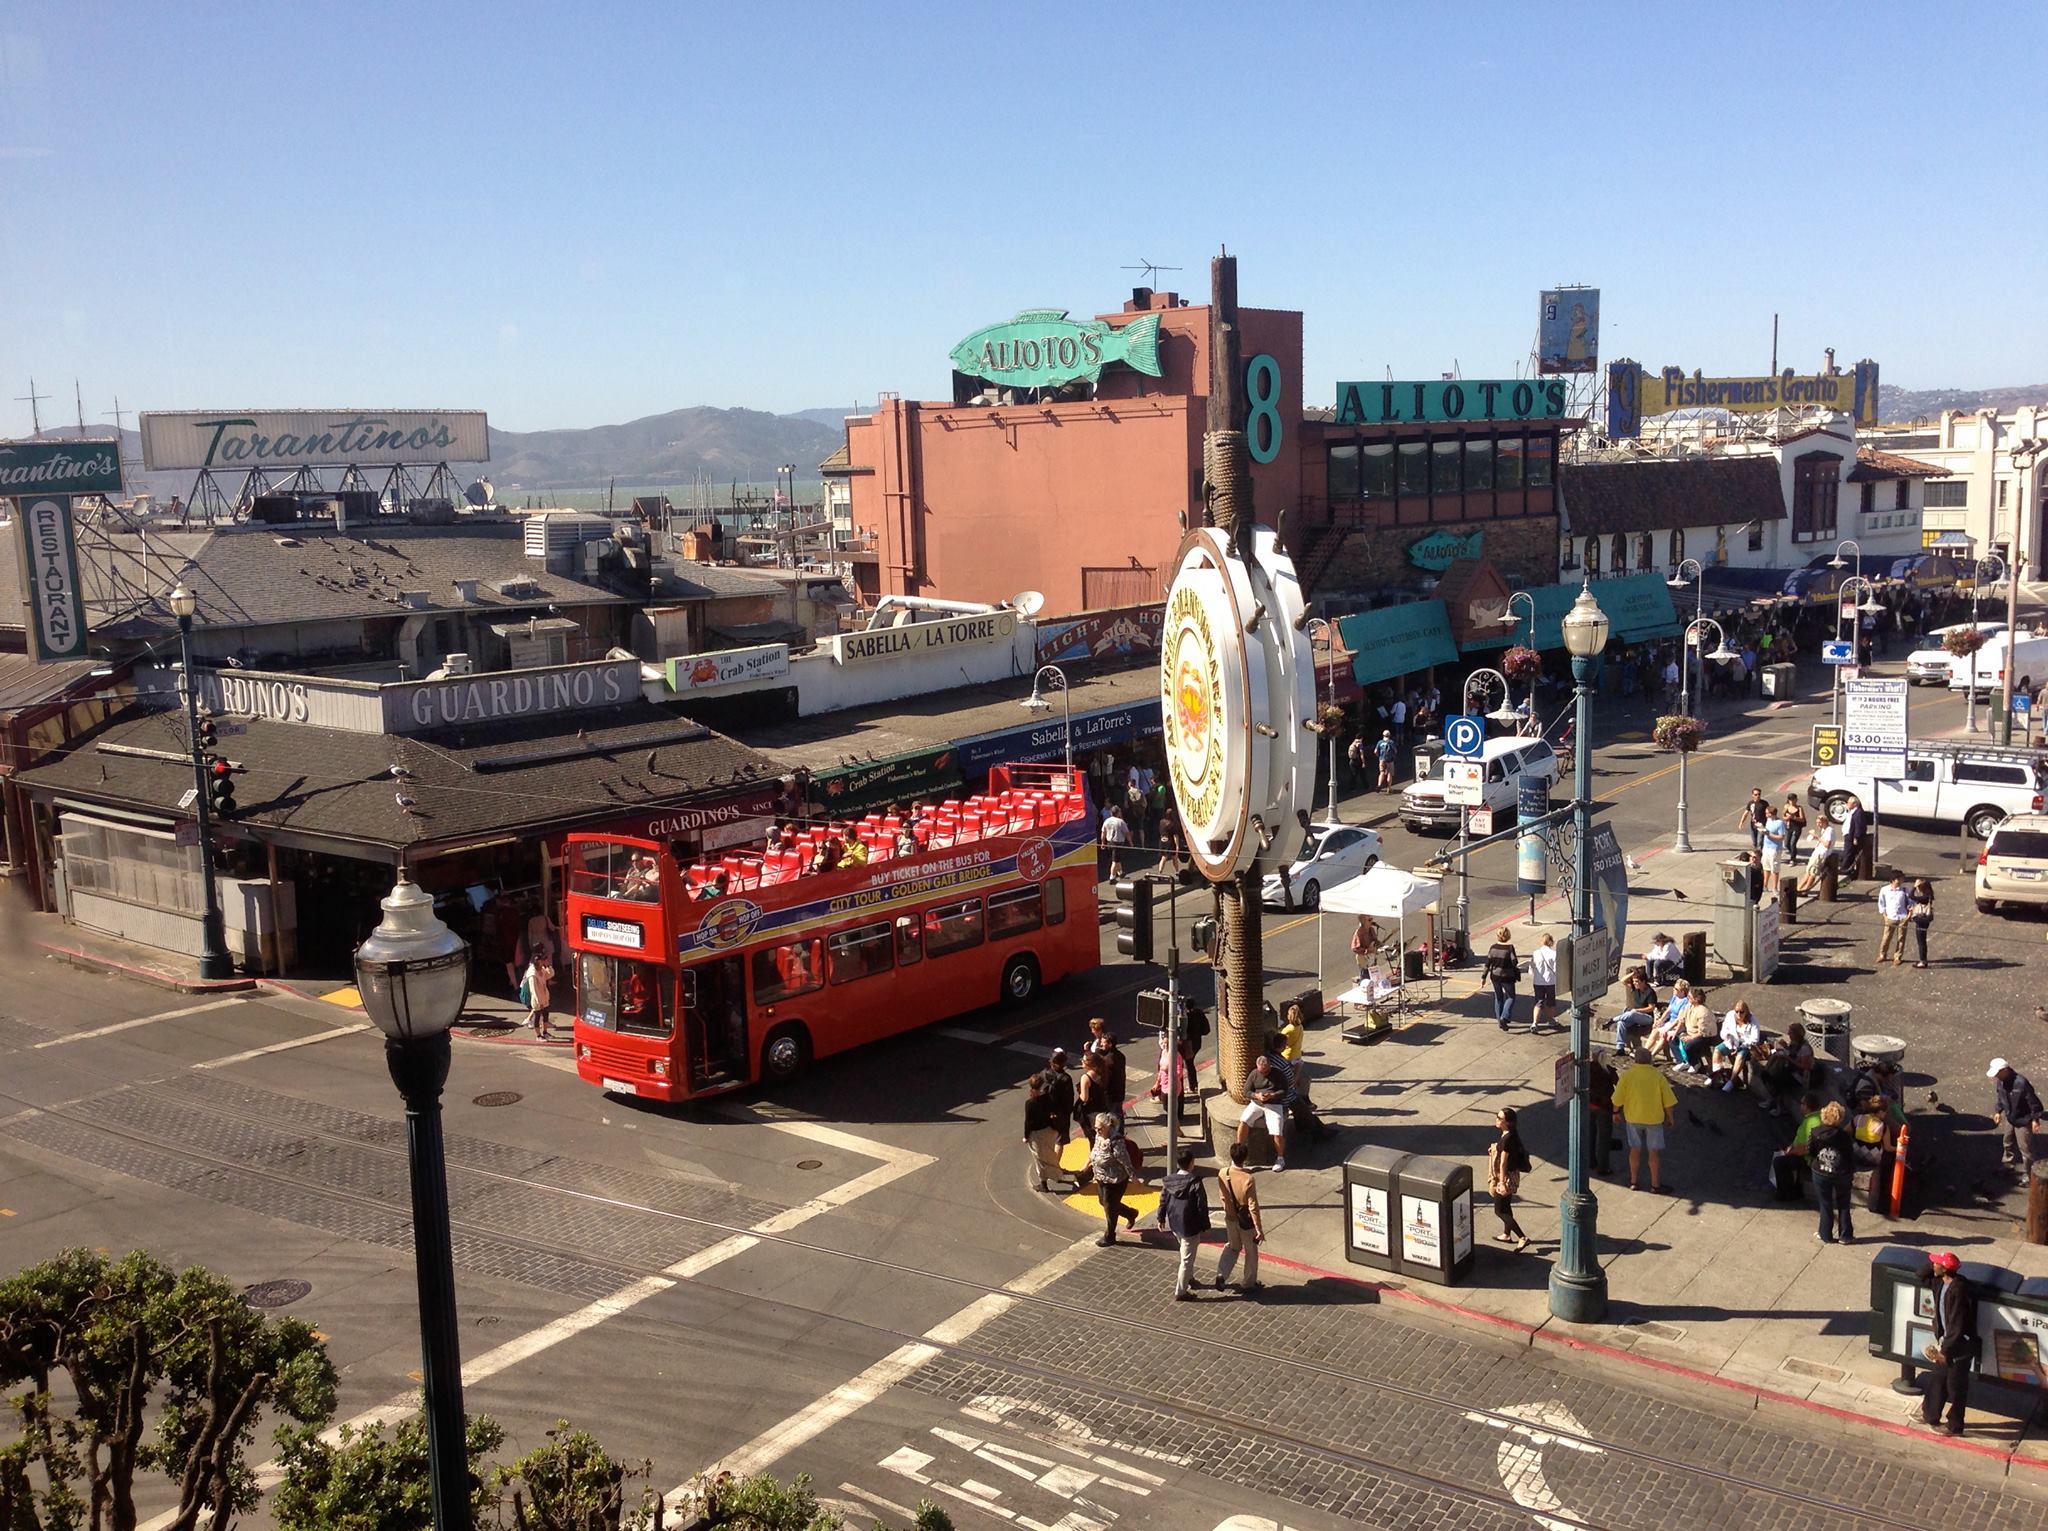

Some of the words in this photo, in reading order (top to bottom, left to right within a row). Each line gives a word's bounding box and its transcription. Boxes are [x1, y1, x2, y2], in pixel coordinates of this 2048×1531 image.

[979, 331, 1102, 372] ALIOTO'S
[1662, 365, 1778, 406] Fishermen's
[1781, 367, 1839, 403] Grotto
[1246, 353, 1283, 465] 8
[1340, 382, 1566, 424] ALIOTO'S
[192, 414, 458, 467] Tarantino's
[36, 509, 71, 647] RESTAURANT
[847, 635, 911, 660] SABELLA
[926, 628, 945, 648] LA
[948, 619, 995, 645] TORRE
[1039, 619, 1101, 661] LIGHT
[720, 664, 744, 681] Crab
[746, 650, 781, 671] Station
[411, 666, 622, 726] GUARDINO'S
[217, 726, 241, 737] YLOR
[1074, 726, 1082, 737] &
[1086, 711, 1132, 735] LaTorre's
[1456, 724, 1474, 748] P
[1848, 734, 1881, 744] $3.00
[849, 776, 868, 793] Crab
[868, 763, 897, 783] Station
[1448, 783, 1479, 793] Fisherman's
[1448, 789, 1465, 797] Wharf
[648, 804, 741, 837] GUARDINO'S
[1593, 831, 1613, 853] PORT
[871, 871, 891, 886] BUY
[892, 865, 921, 882] TICKET
[921, 861, 937, 877] ON
[938, 858, 955, 873] THE
[955, 854, 973, 869] BUS
[973, 850, 991, 867] FOR
[1031, 853, 1040, 866] 2
[829, 897, 850, 913] CITY
[853, 890, 881, 908] TOUR
[891, 880, 931, 898] GOLDEN
[933, 873, 957, 889] GATE
[958, 865, 994, 883] BRIDGE.
[587, 918, 607, 929] DELUXE
[695, 931, 709, 942] HOP
[708, 927, 718, 936] ON
[738, 913, 751, 924] HOP
[750, 909, 761, 919] OFF
[1582, 959, 1601, 977] MUST
[1358, 1213, 1379, 1224] PORT
[1409, 1226, 1430, 1237] PORT
[2031, 1317, 2048, 1330] iPa
